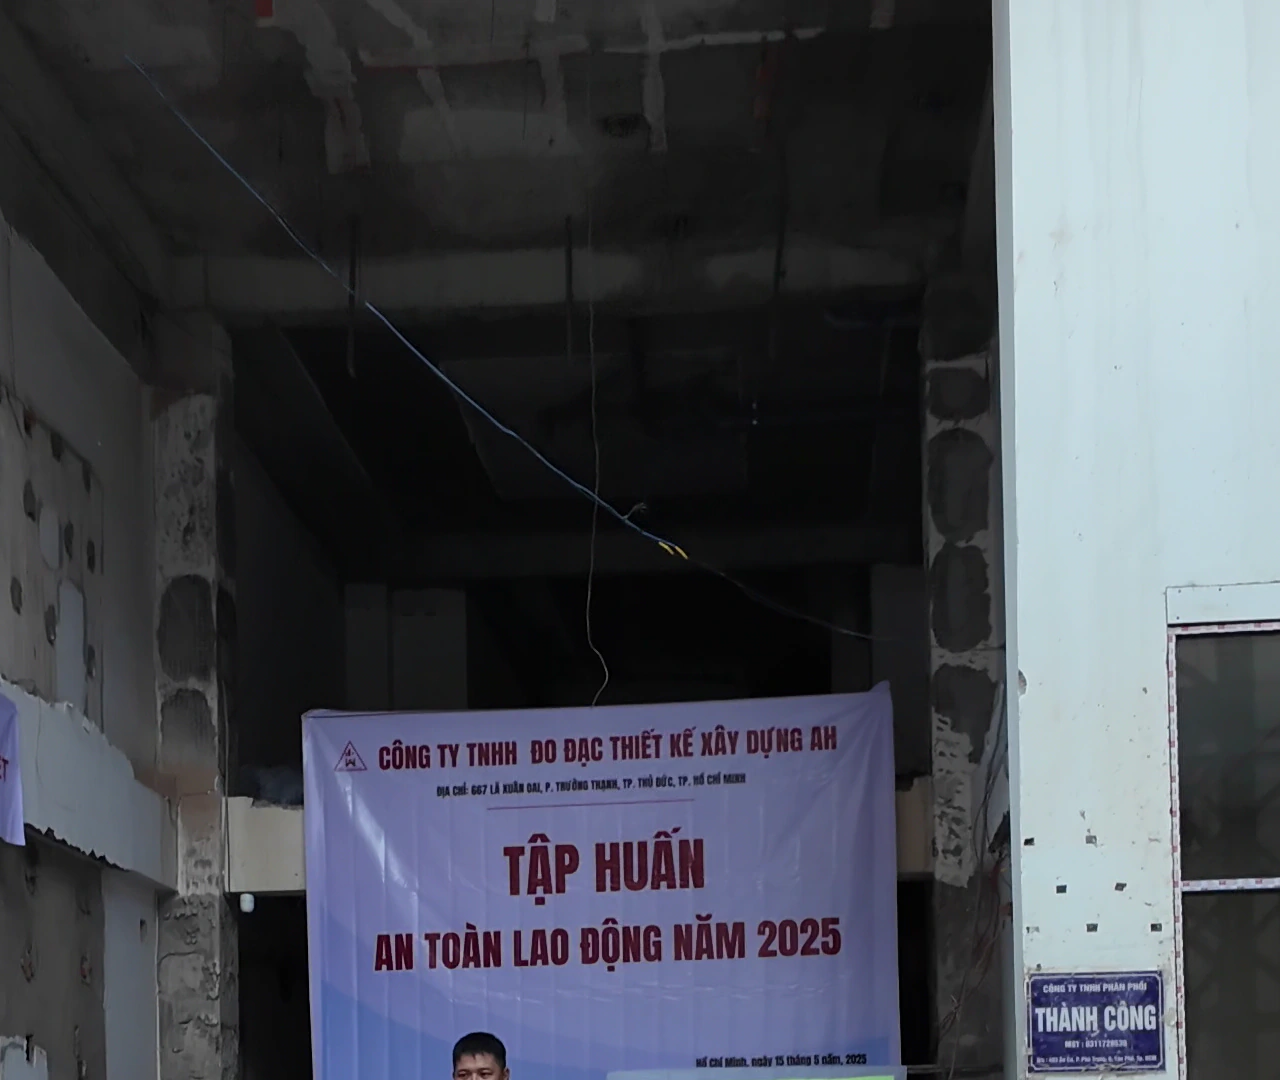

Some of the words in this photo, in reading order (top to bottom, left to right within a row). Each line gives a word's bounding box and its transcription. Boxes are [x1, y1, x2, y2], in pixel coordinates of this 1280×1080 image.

[378, 740, 430, 770] CÔNG
[437, 744, 460, 768] TY
[466, 741, 517, 766] TNHH
[530, 739, 557, 764] ĐO
[563, 737, 603, 767] ĐẠC
[609, 729, 662, 760] THIẾT
[670, 726, 697, 757] KẾ
[701, 724, 740, 756] XÂY
[746, 727, 802, 759] DỰNG
[810, 725, 837, 751] AH
[471, 784, 487, 796] 667
[622, 777, 636, 790] TP.
[678, 775, 691, 788] TP.
[723, 773, 746, 785] MINH
[503, 833, 580, 905] TẬP
[594, 827, 705, 892] HUẤN
[374, 933, 413, 971] AN
[424, 922, 502, 970] TOÀN
[513, 929, 569, 968] LAO
[580, 918, 662, 972] ĐỘNG
[673, 913, 746, 961] NĂM
[757, 918, 842, 959] 2025
[1067, 984, 1077, 992] TY
[1079, 983, 1101, 992] TNHH
[1034, 1001, 1098, 1033] THÀNH
[1103, 1000, 1157, 1031] CÔNG
[775, 1055, 784, 1066] 15
[814, 1054, 820, 1066] 5
[846, 1053, 867, 1065] 2025
